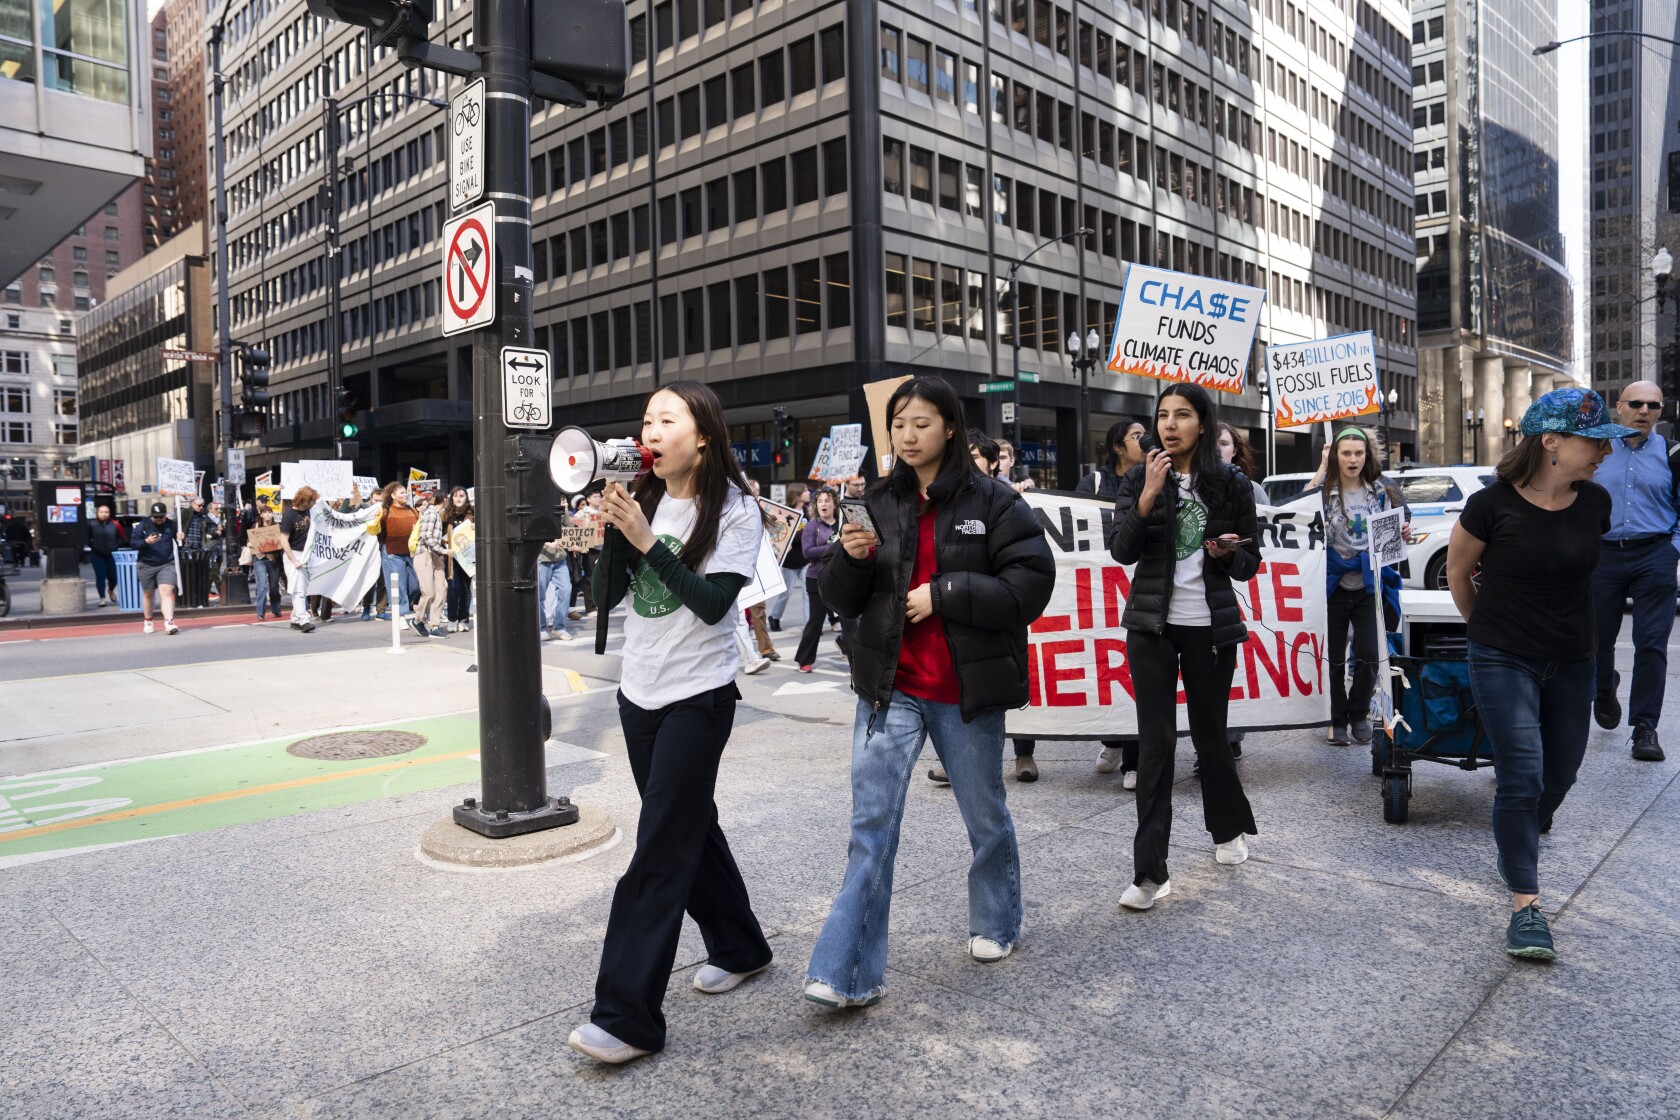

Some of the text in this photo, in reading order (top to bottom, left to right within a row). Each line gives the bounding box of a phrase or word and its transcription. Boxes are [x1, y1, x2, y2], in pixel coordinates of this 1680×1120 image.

[460, 135, 473, 155] USE
[460, 155, 474, 176] BIKE
[455, 173, 478, 198] SIGNAL
[1139, 280, 1251, 323] CHA$E
[1157, 315, 1218, 345] FUNDS
[1123, 338, 1240, 377] CLIMATE CHAOS
[1272, 342, 1371, 371] $434 BILLION IN
[511, 374, 541, 386] LOOK
[1276, 362, 1373, 395] FOSSIL FUELS
[520, 387, 534, 398] FOR
[1294, 389, 1365, 415] SINCE 2016
[356, 477, 375, 485] LEAVE
[650, 604, 670, 615] U.S.
